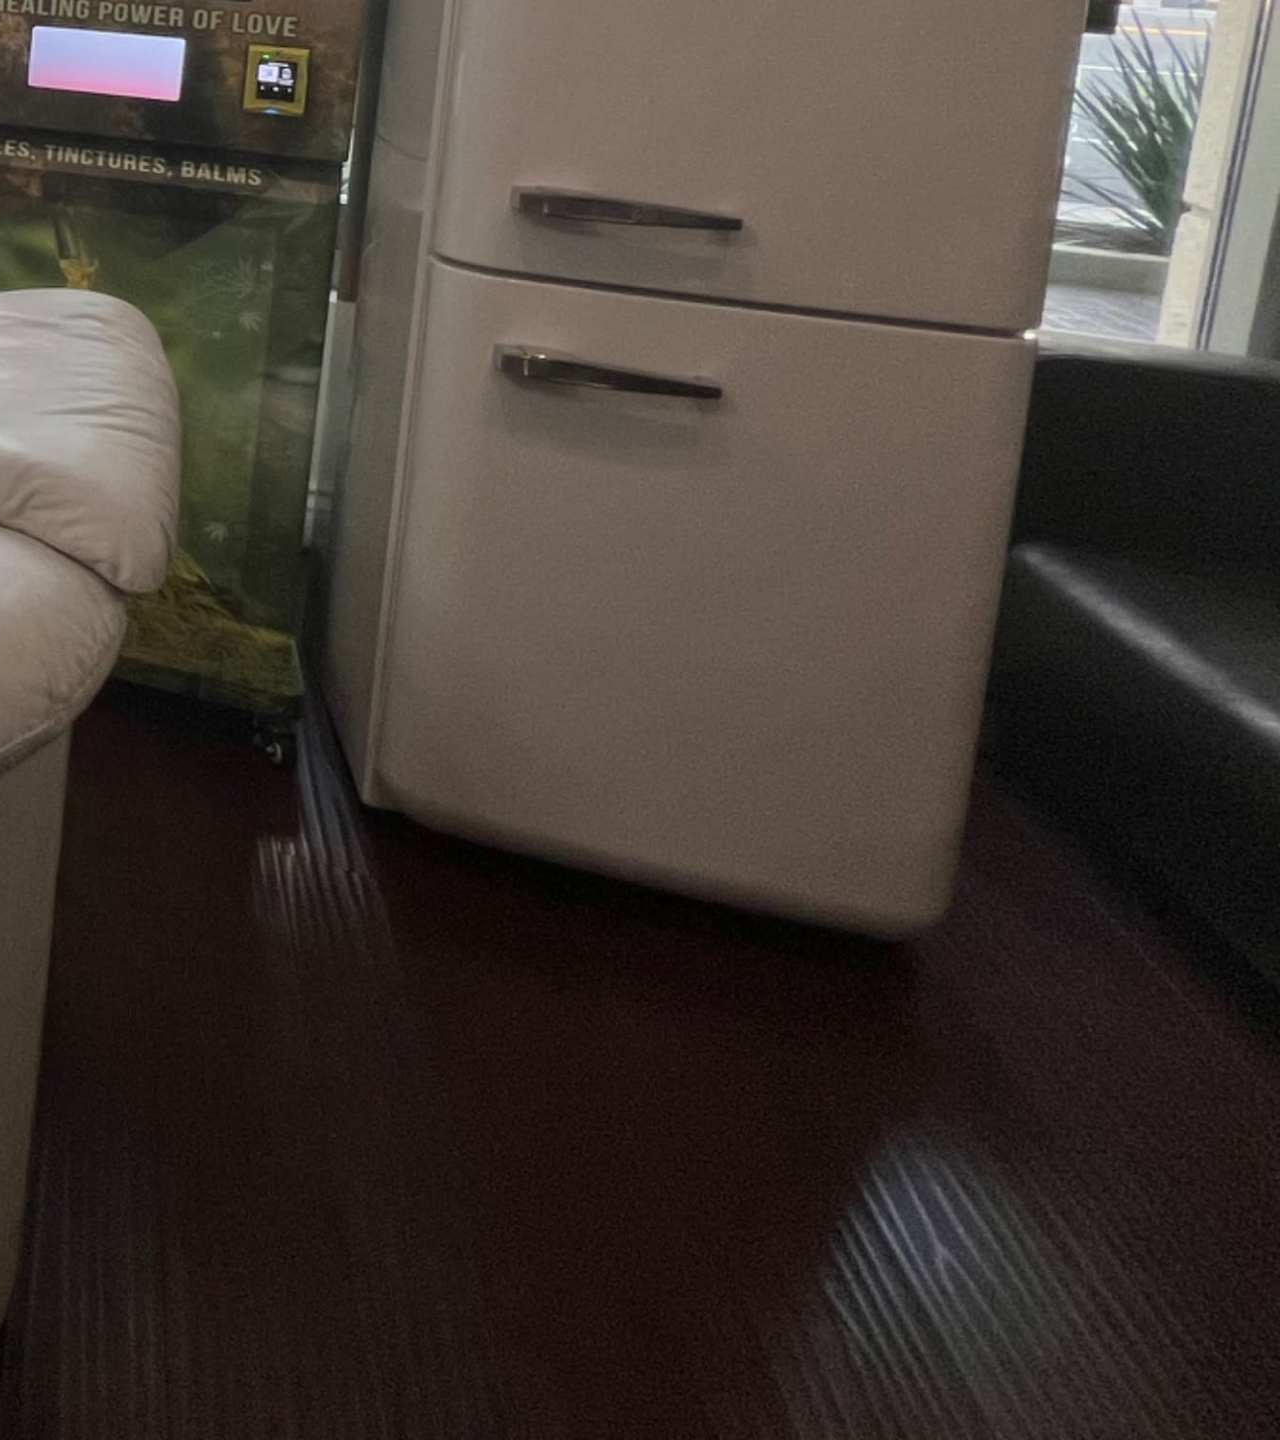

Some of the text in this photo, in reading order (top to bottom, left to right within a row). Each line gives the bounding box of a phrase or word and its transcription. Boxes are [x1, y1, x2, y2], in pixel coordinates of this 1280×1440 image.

[97, 1, 184, 28] POWER
[192, 9, 224, 30] OF
[232, 12, 298, 38] LOVE
[44, 143, 173, 178] TINCTURES,
[180, 160, 263, 187] BALMS
